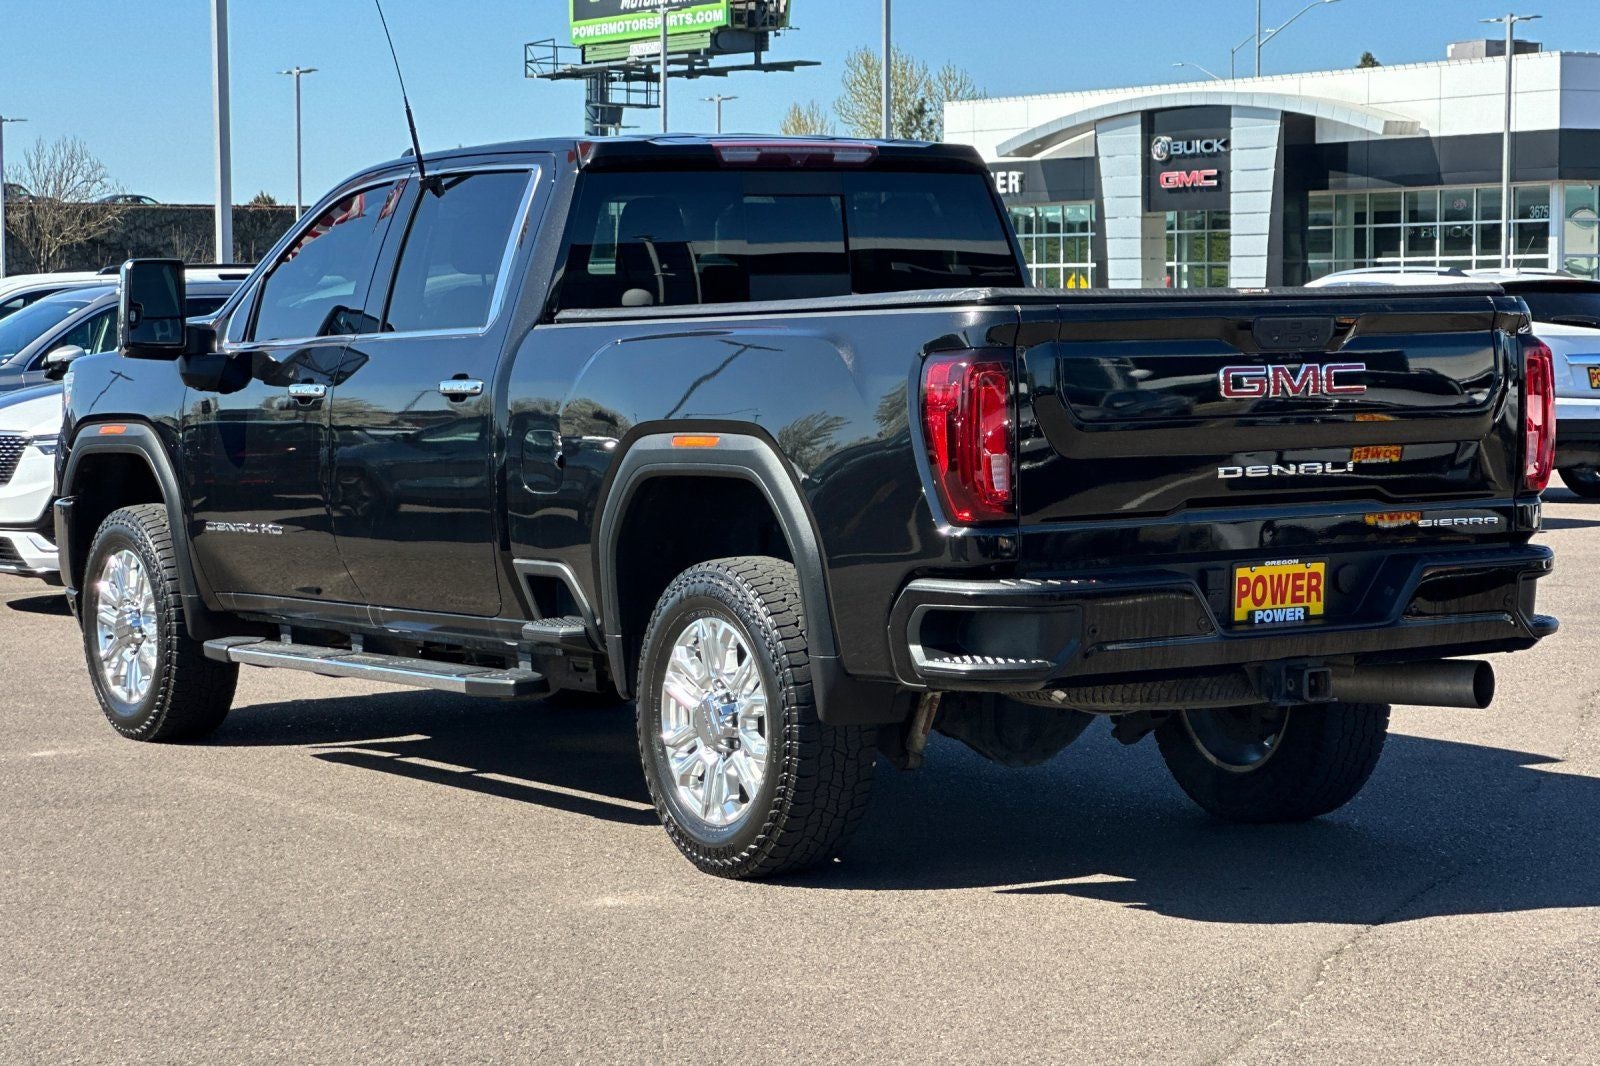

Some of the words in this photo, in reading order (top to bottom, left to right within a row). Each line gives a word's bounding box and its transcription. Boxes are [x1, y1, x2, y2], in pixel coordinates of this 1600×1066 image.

[572, 9, 723, 38] POWERMOTORSPRTS.COM
[1170, 138, 1227, 155] BUICK
[1160, 168, 1218, 188] GMC
[1529, 205, 1549, 219] 3675
[1219, 363, 1367, 398] GMC
[1217, 461, 1354, 479] DENALI
[1418, 516, 1499, 527] SIERRA
[1264, 558, 1299, 566] OREGON
[1236, 571, 1322, 608] POWER
[1254, 607, 1304, 624] POWER
